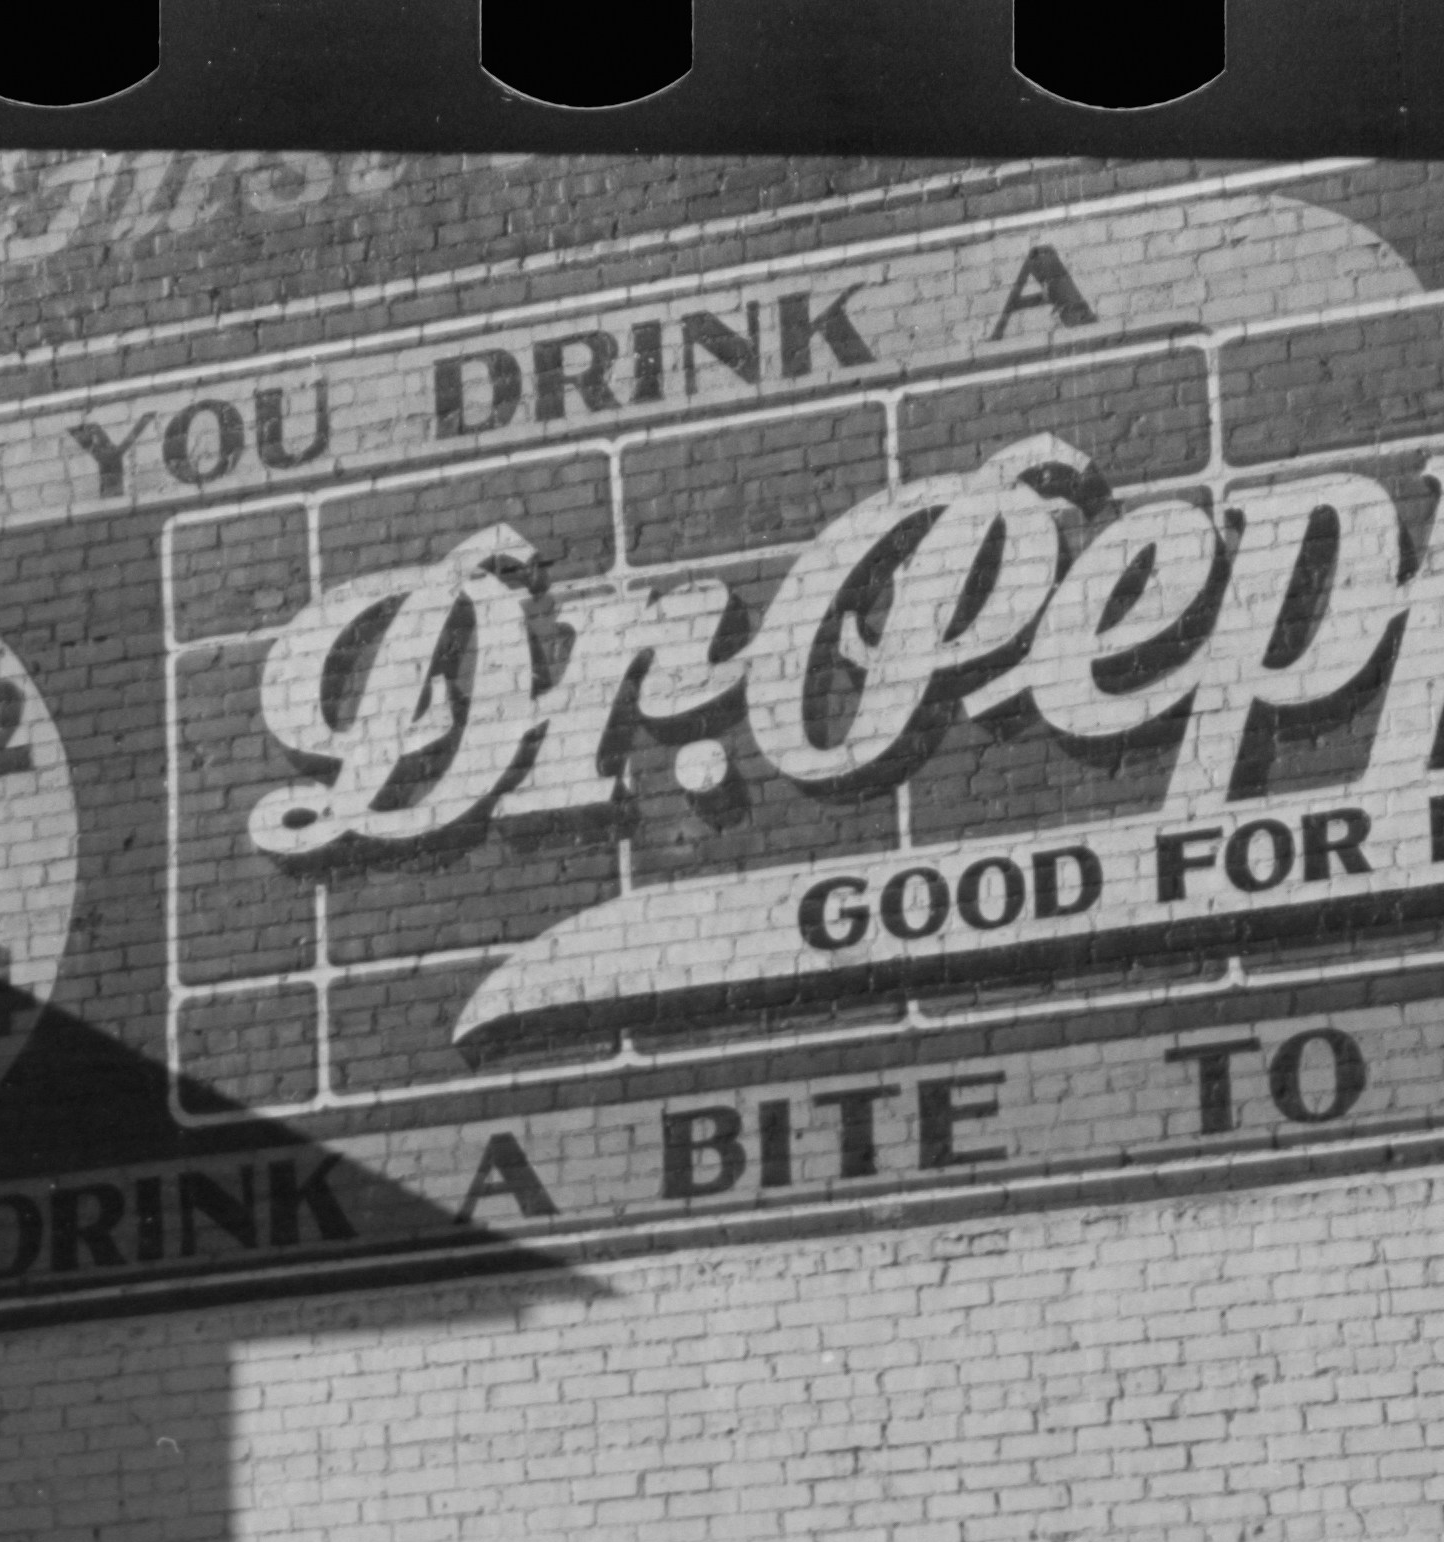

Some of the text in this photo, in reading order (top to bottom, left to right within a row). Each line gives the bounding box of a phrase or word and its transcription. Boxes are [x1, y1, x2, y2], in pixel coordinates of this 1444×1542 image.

[68, 378, 331, 499] YOU
[432, 282, 878, 440] DRINK
[990, 243, 1098, 341] A
[247, 524, 731, 855] Dr.
[797, 844, 1104, 952] GOOD
[1156, 805, 1374, 903] FOR
[457, 1131, 561, 1225] A
[661, 1071, 1008, 1199] BITE
[1164, 1027, 1368, 1135] TO
